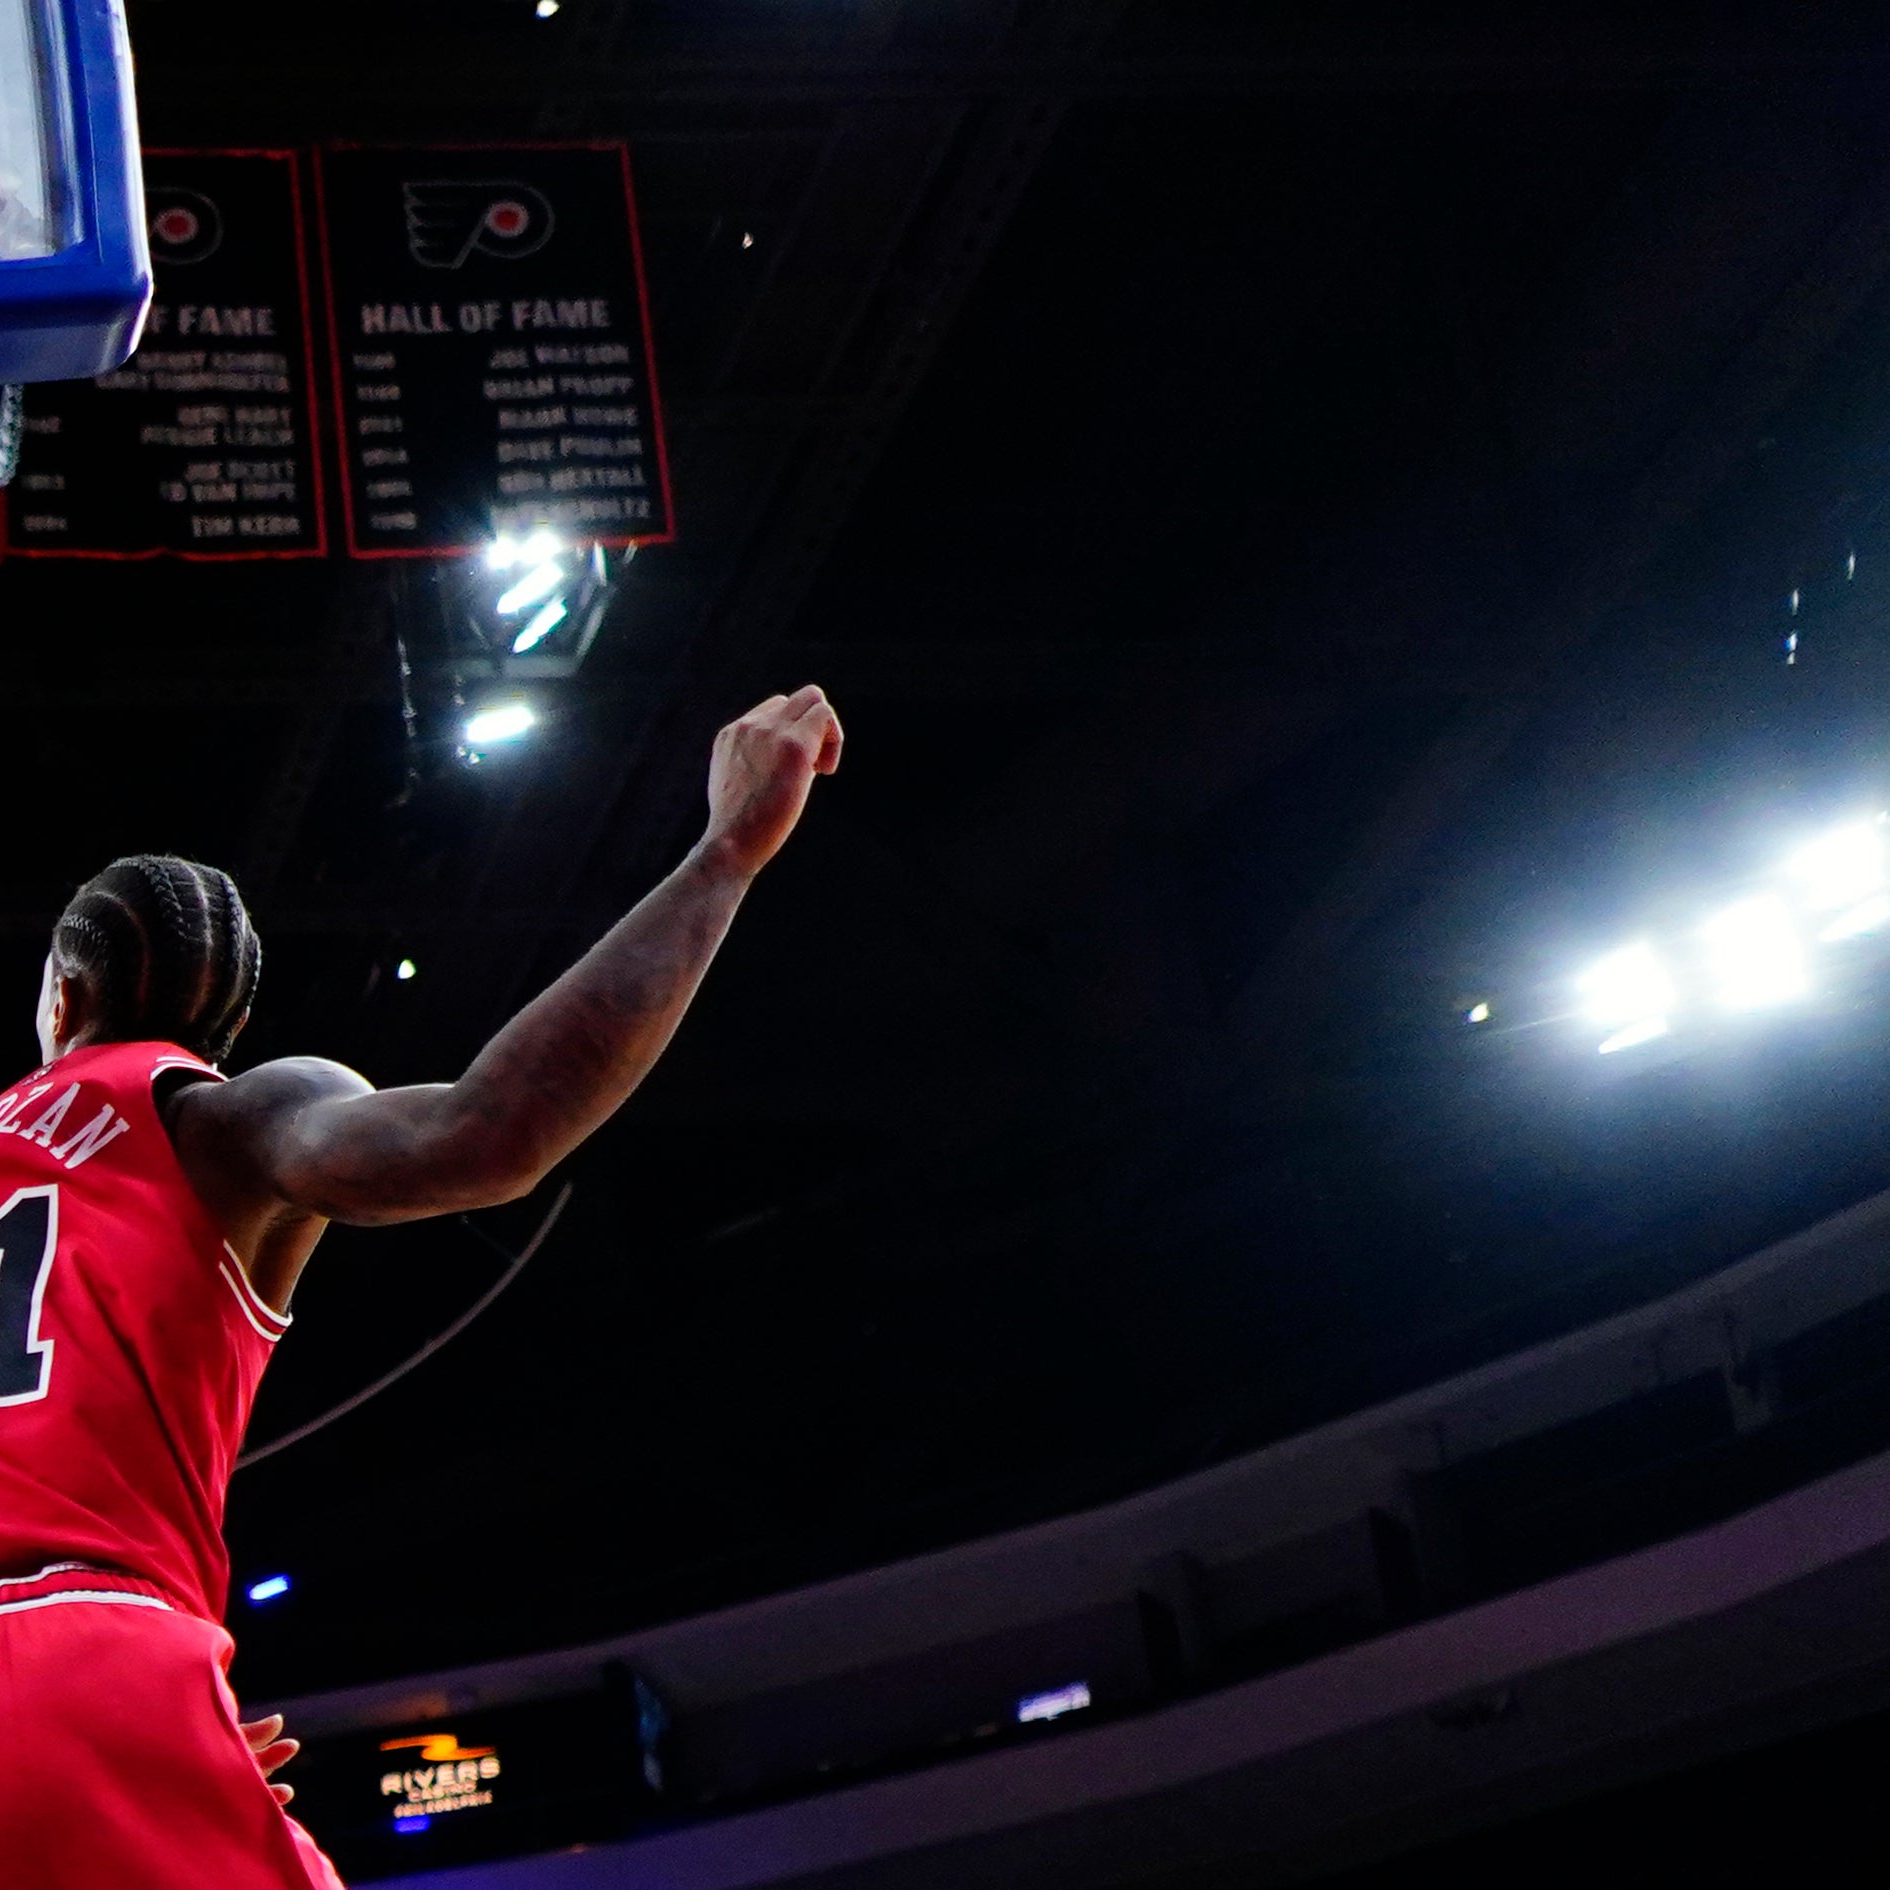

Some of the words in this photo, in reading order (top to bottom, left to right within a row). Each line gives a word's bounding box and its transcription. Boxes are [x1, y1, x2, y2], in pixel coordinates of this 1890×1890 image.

[177, 304, 277, 336] FAME
[361, 302, 453, 335] HALL
[458, 301, 502, 333] OF
[511, 298, 612, 331] FAME
[381, 1757, 501, 1796] RIVERS
